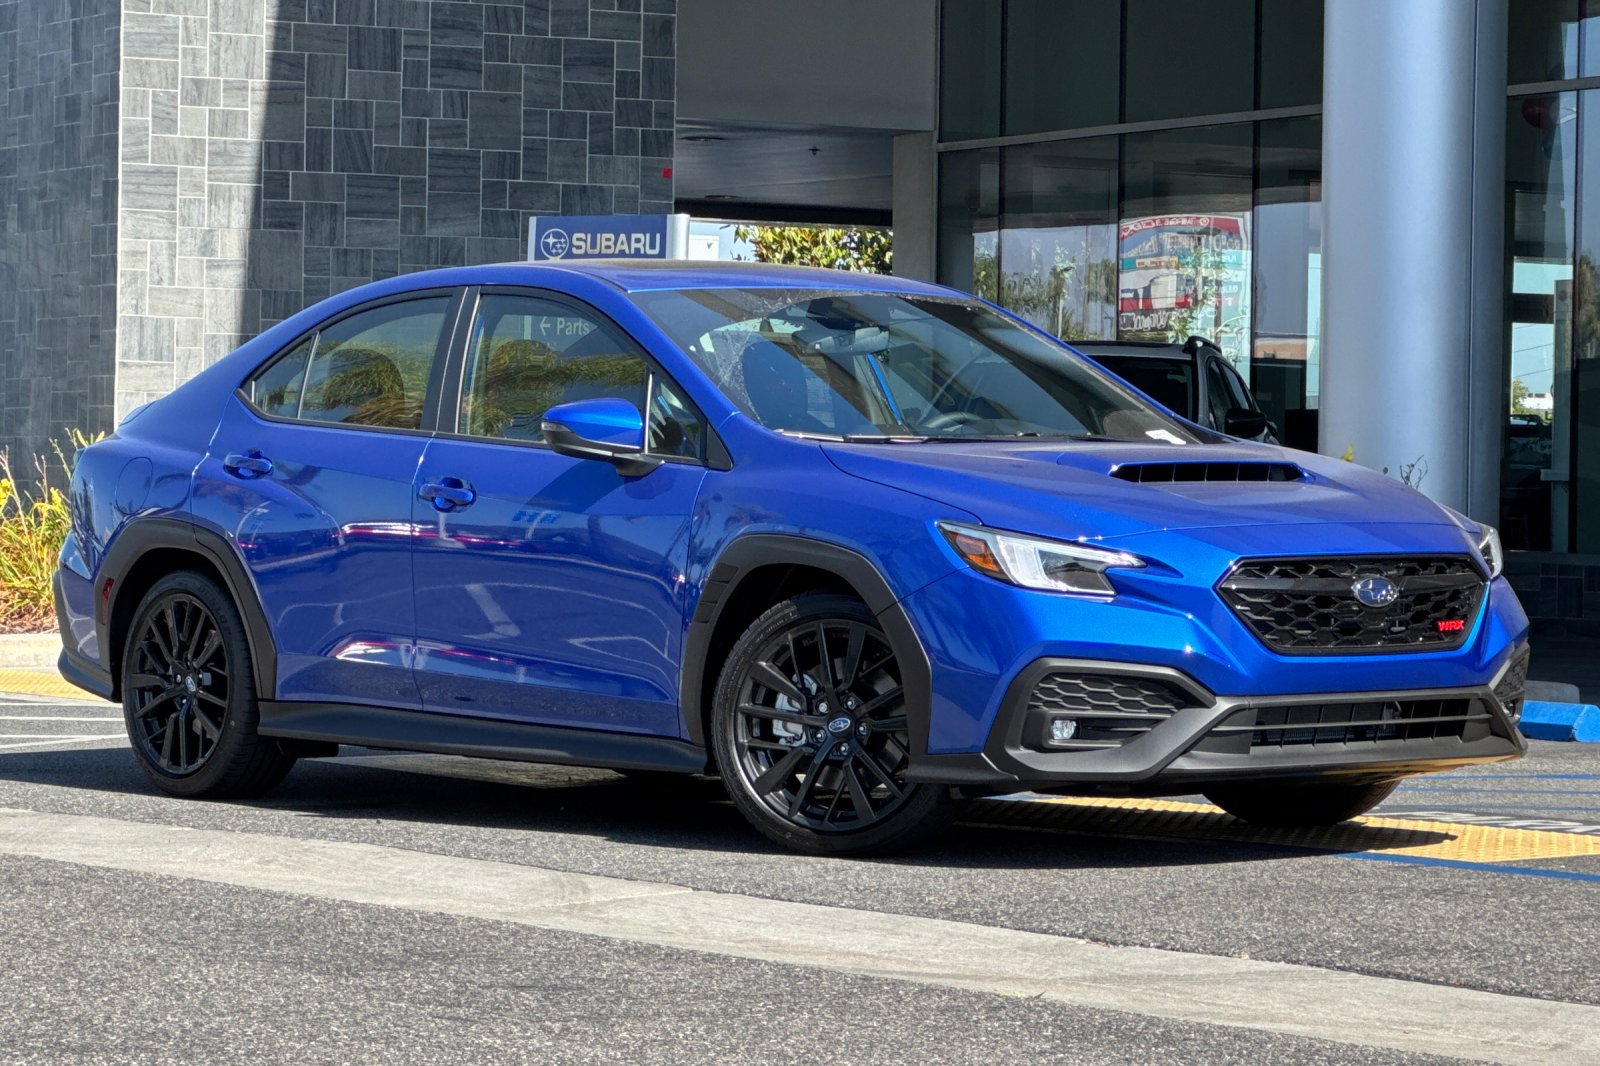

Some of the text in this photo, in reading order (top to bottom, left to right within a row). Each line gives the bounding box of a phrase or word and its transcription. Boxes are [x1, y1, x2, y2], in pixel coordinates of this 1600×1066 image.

[571, 232, 661, 255] SUBARU
[556, 317, 590, 336] Parts
[1437, 620, 1465, 631] WRX
